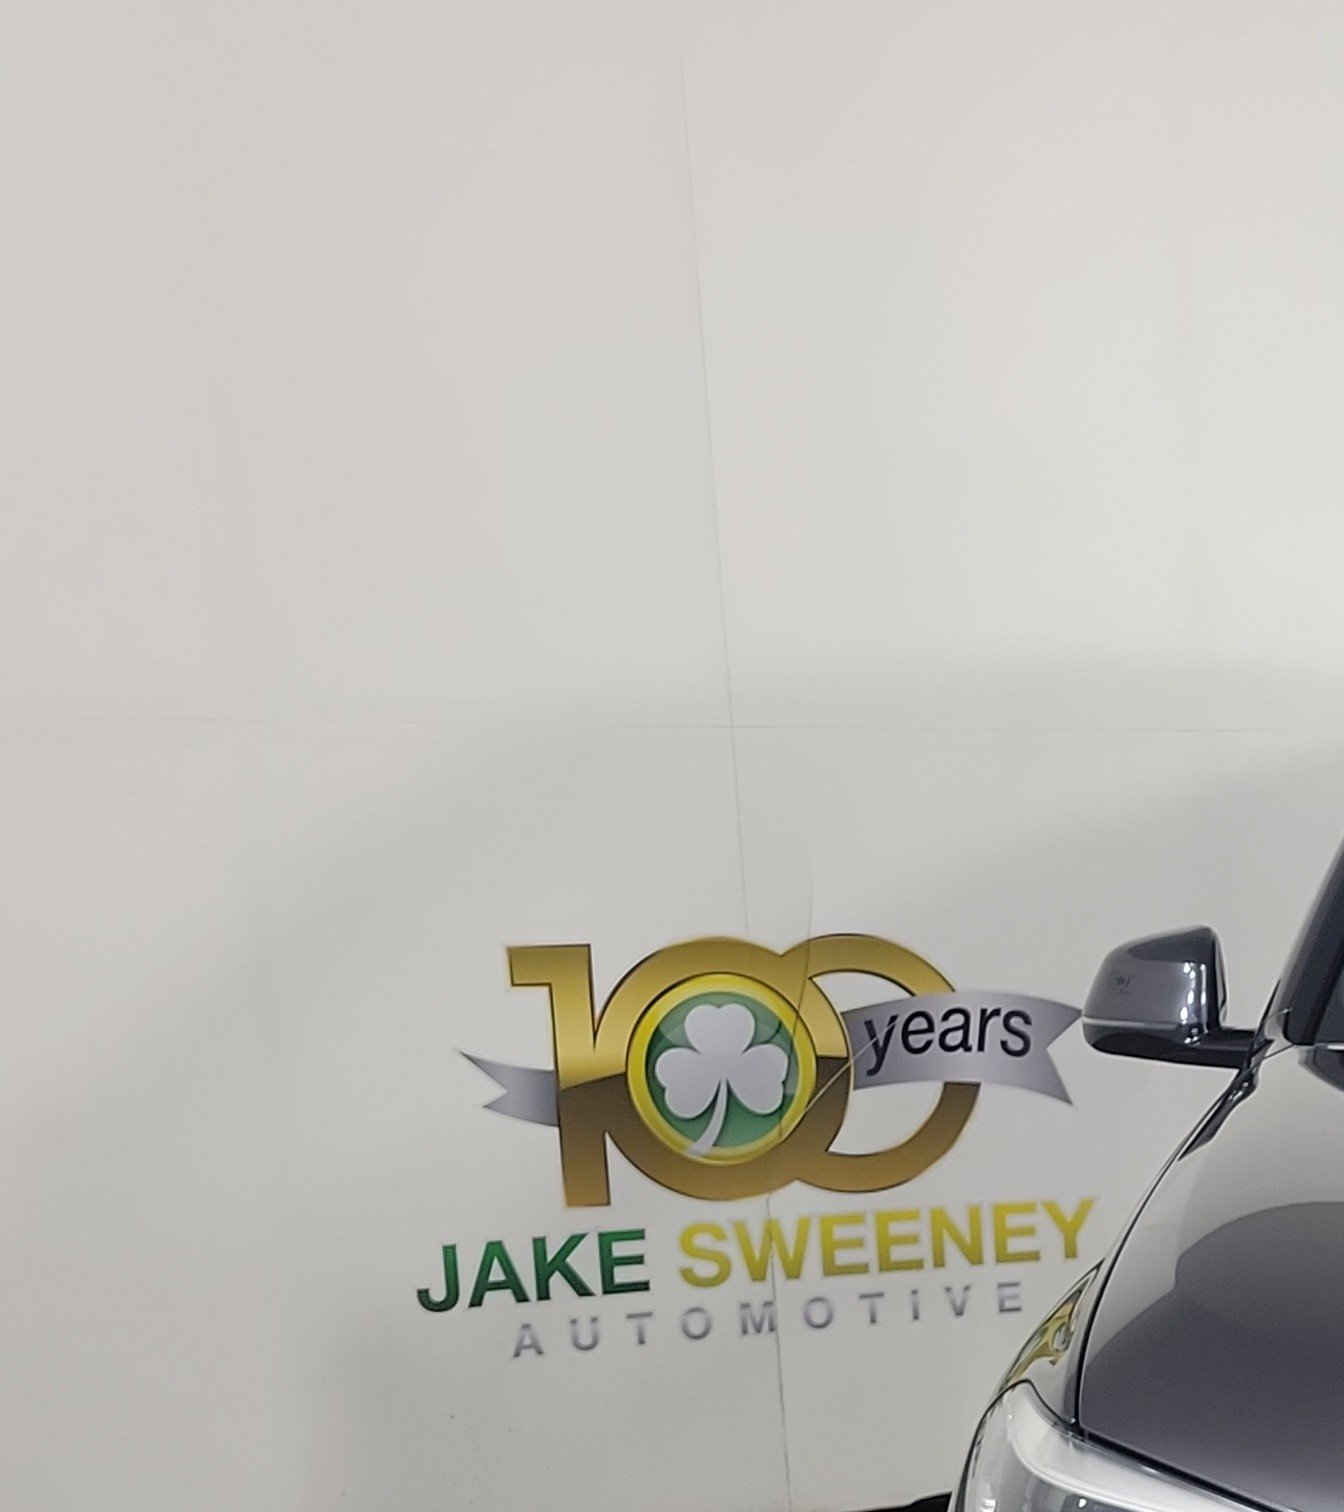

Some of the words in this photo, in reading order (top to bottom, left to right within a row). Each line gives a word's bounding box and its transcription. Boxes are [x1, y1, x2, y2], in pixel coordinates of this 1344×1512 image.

[506, 933, 982, 1208] 100
[865, 1005, 1033, 1076] years
[416, 1228, 651, 1313] JAKE
[678, 1198, 1095, 1288] SWEENEY
[512, 1281, 1023, 1358] AUTOMOTIVE
